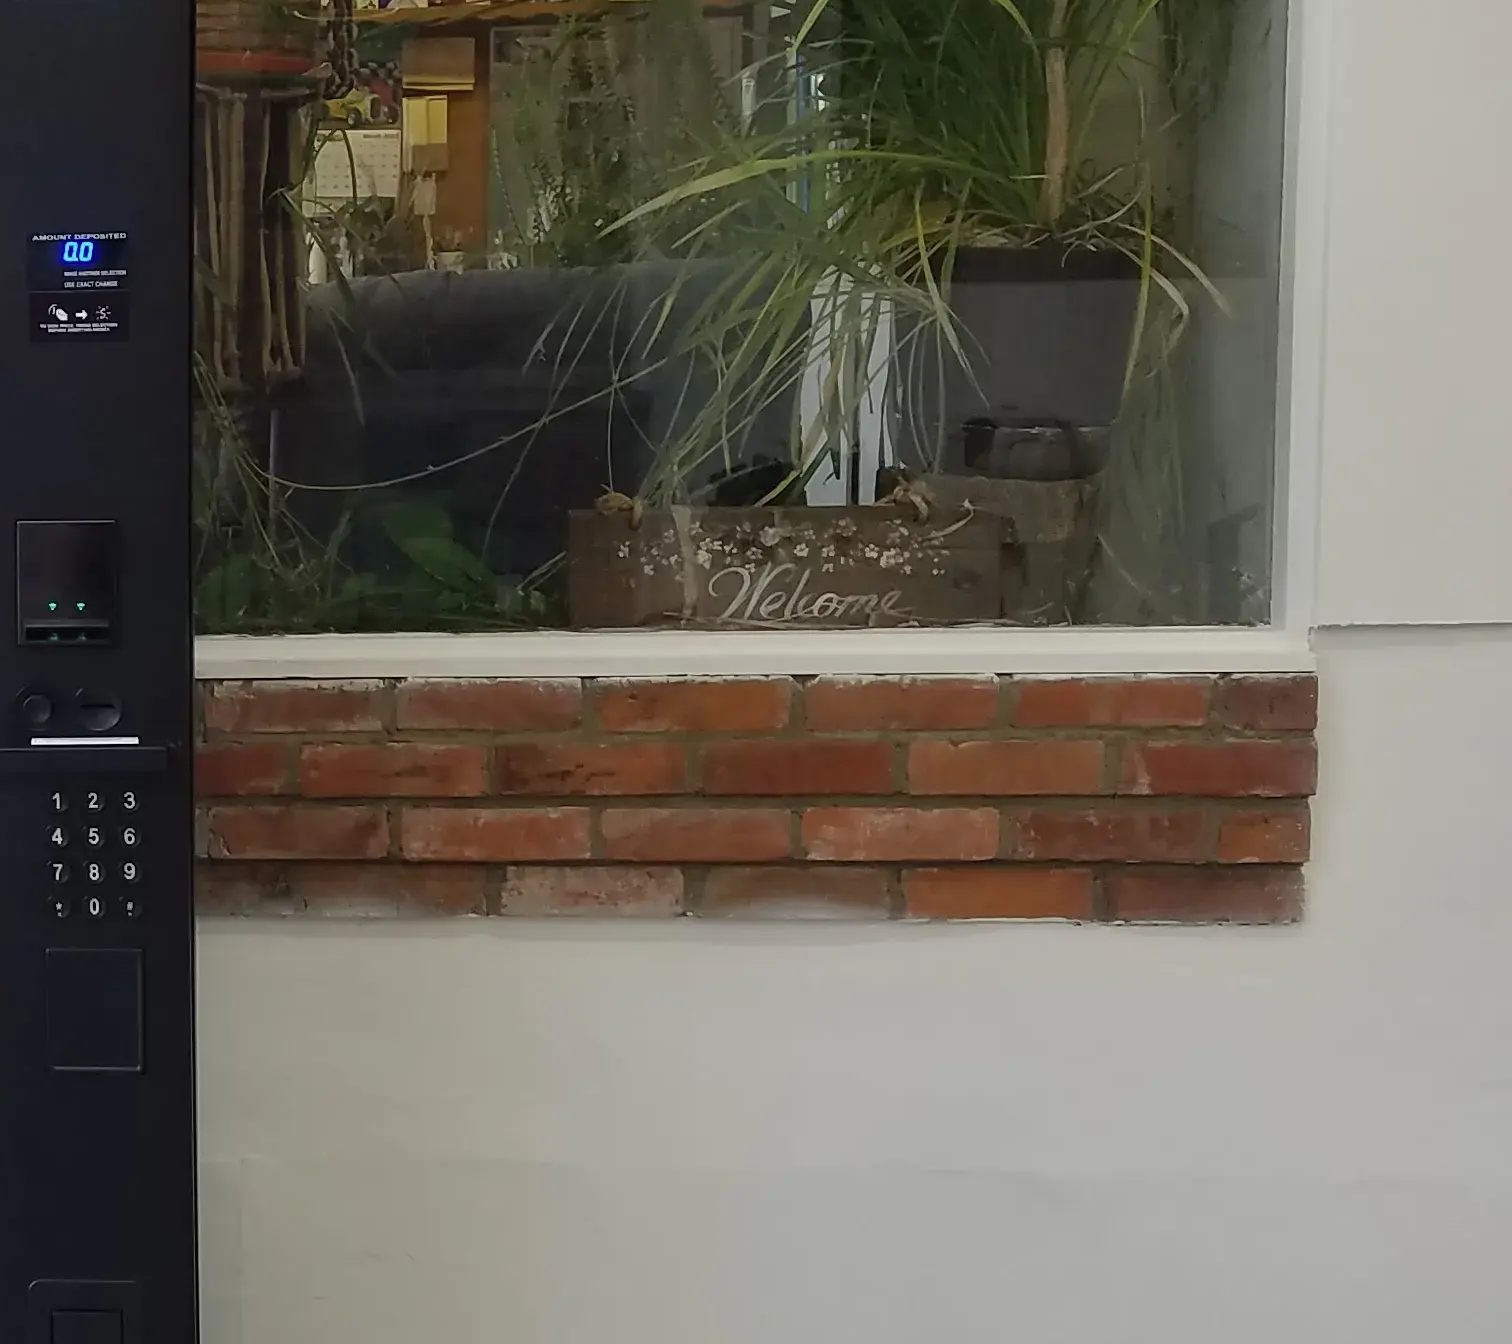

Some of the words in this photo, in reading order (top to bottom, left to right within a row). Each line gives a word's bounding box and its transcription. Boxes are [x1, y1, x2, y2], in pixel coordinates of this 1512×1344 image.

[32, 233, 72, 241] AMOUNT
[74, 232, 127, 240] DEPOSITED
[708, 561, 915, 622] Welcome
[52, 792, 61, 809] 1
[88, 792, 99, 809] 2
[123, 792, 136, 809] 3
[51, 827, 63, 844] 4
[88, 828, 100, 844] 5
[123, 827, 136, 844] 6
[53, 863, 63, 880] 7
[89, 863, 100, 880] 8
[123, 863, 136, 880] 9
[89, 898, 100, 914] 0
